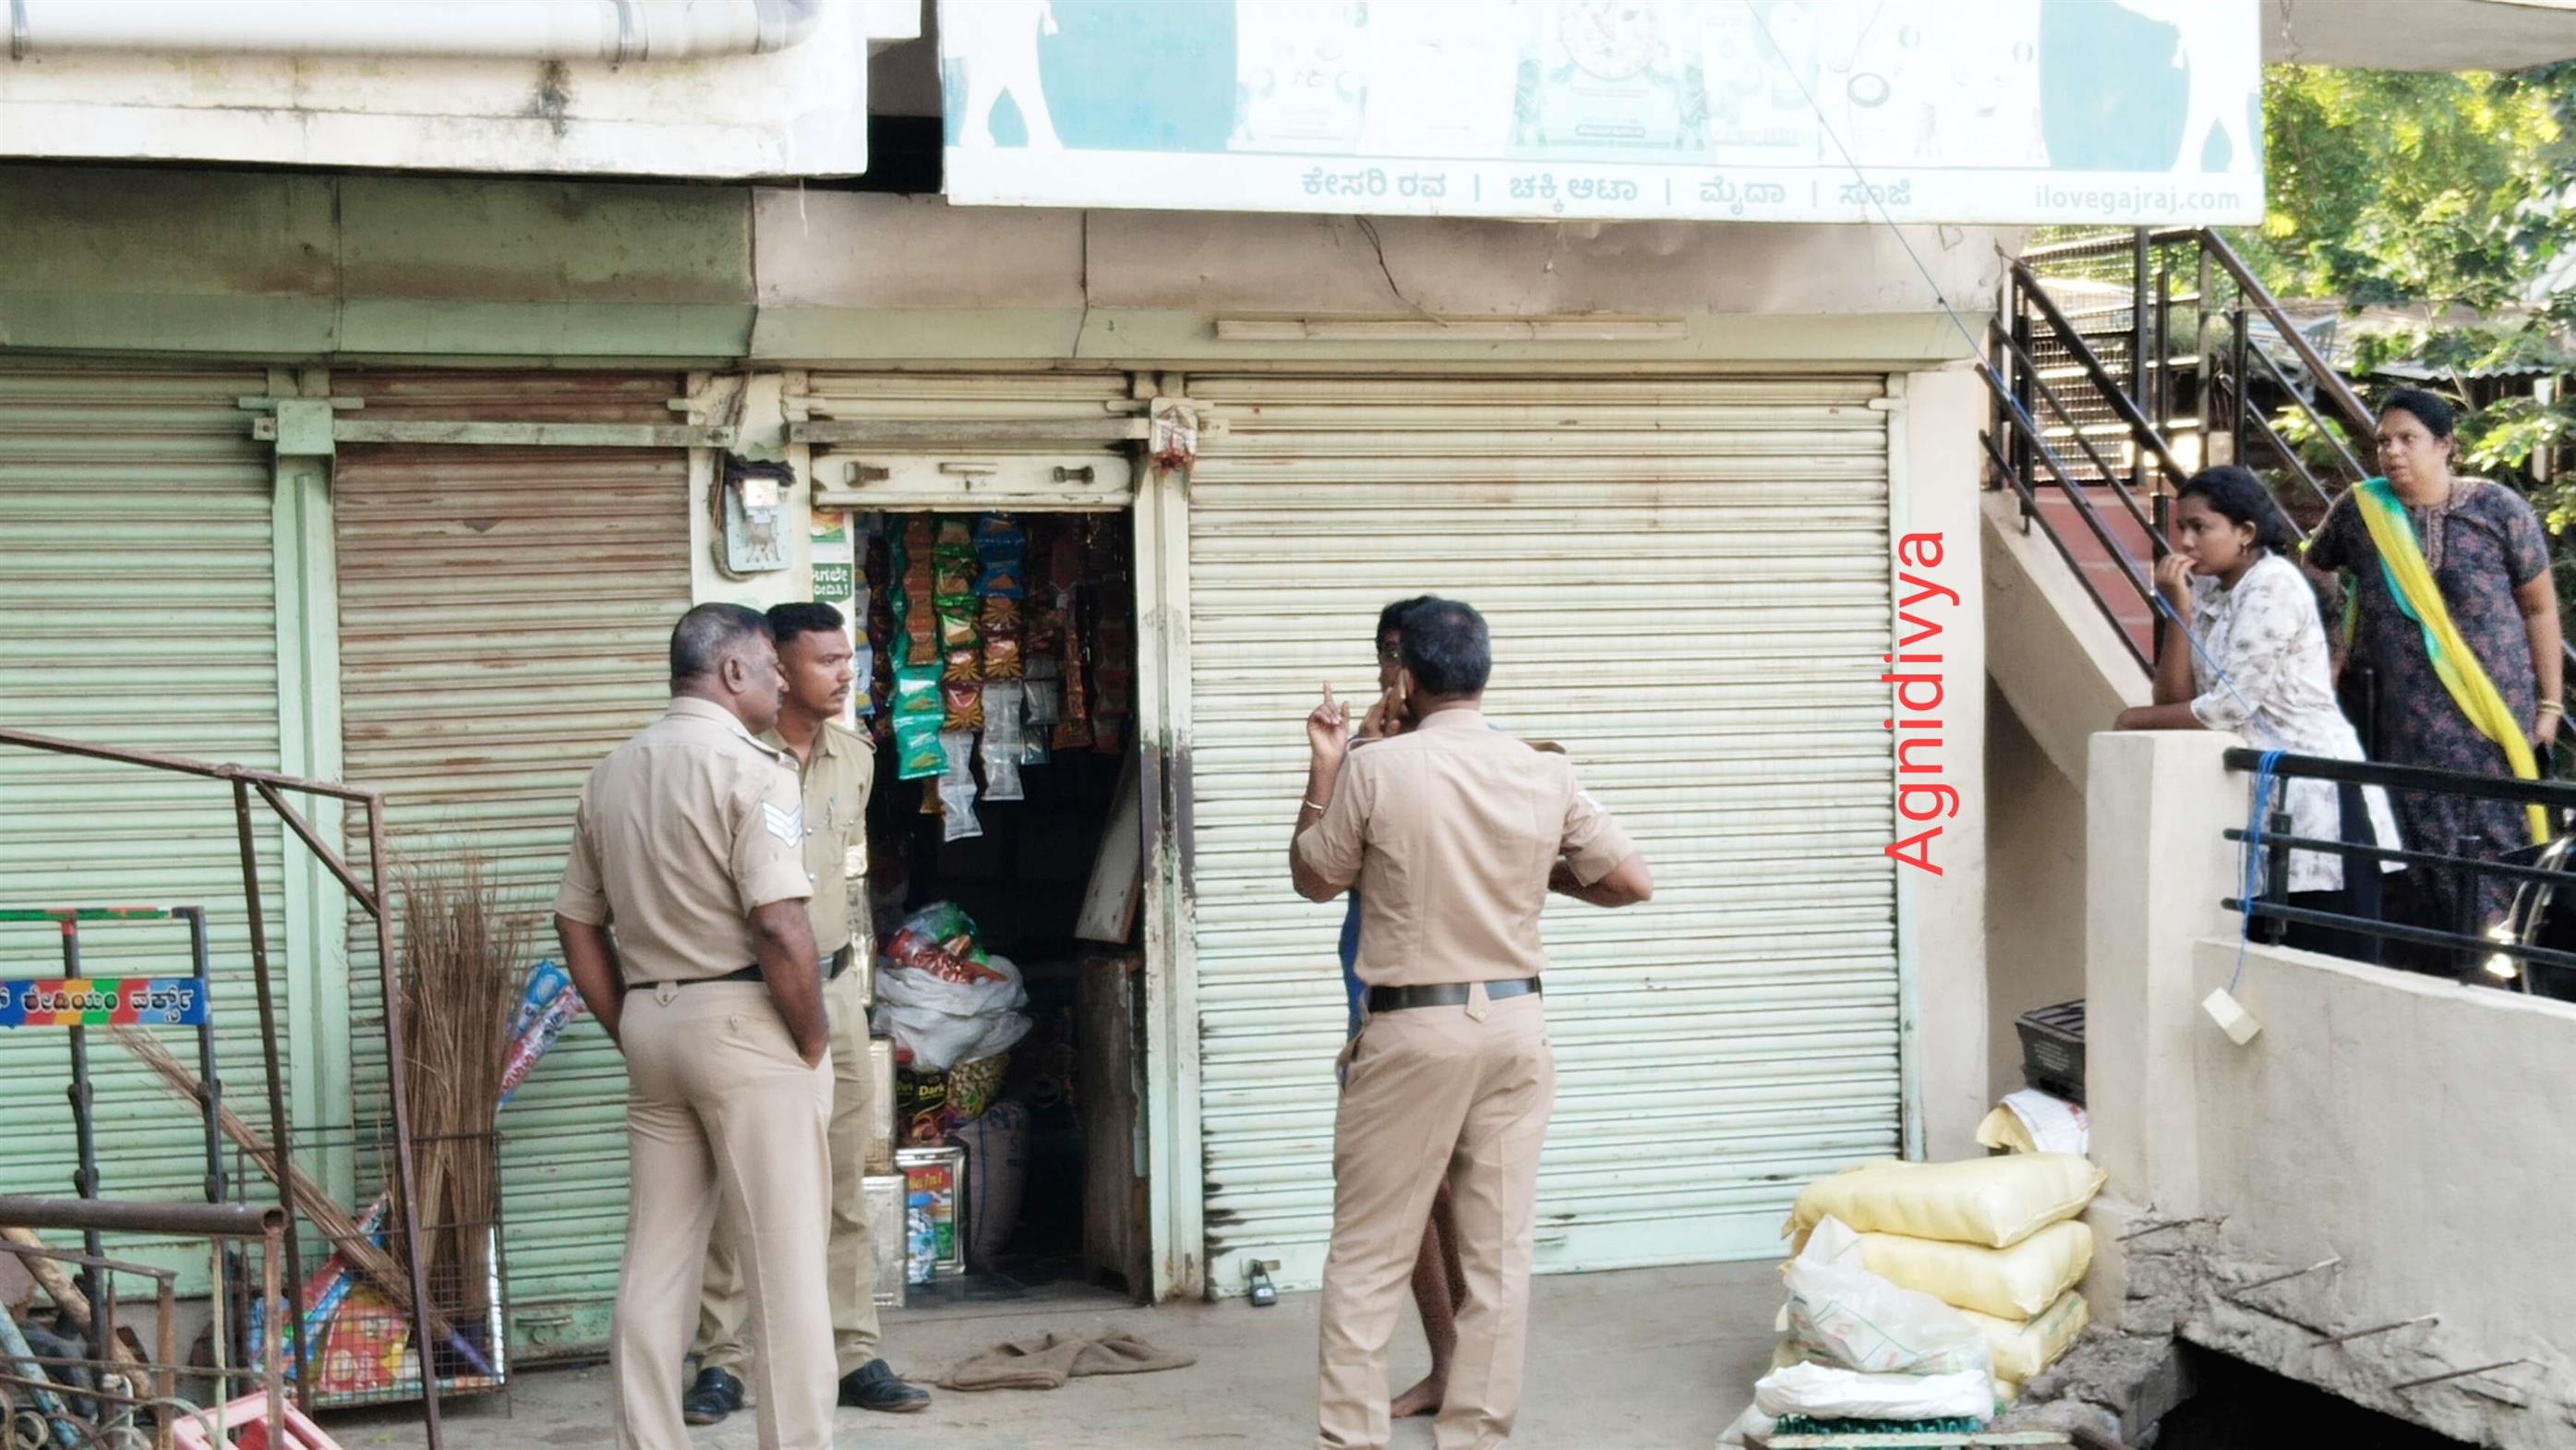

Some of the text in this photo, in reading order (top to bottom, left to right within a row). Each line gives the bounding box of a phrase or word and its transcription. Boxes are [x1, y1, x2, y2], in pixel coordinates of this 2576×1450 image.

[1301, 166, 1912, 214] ಕೇಸರಿ ರವ ಚಕ್ಕಿ ಆಟಾ ಮೈದಾ ಸೂಜಿ
[2034, 185, 2241, 215] ilovegajraj.com
[919, 1082, 945, 1096] Dark
